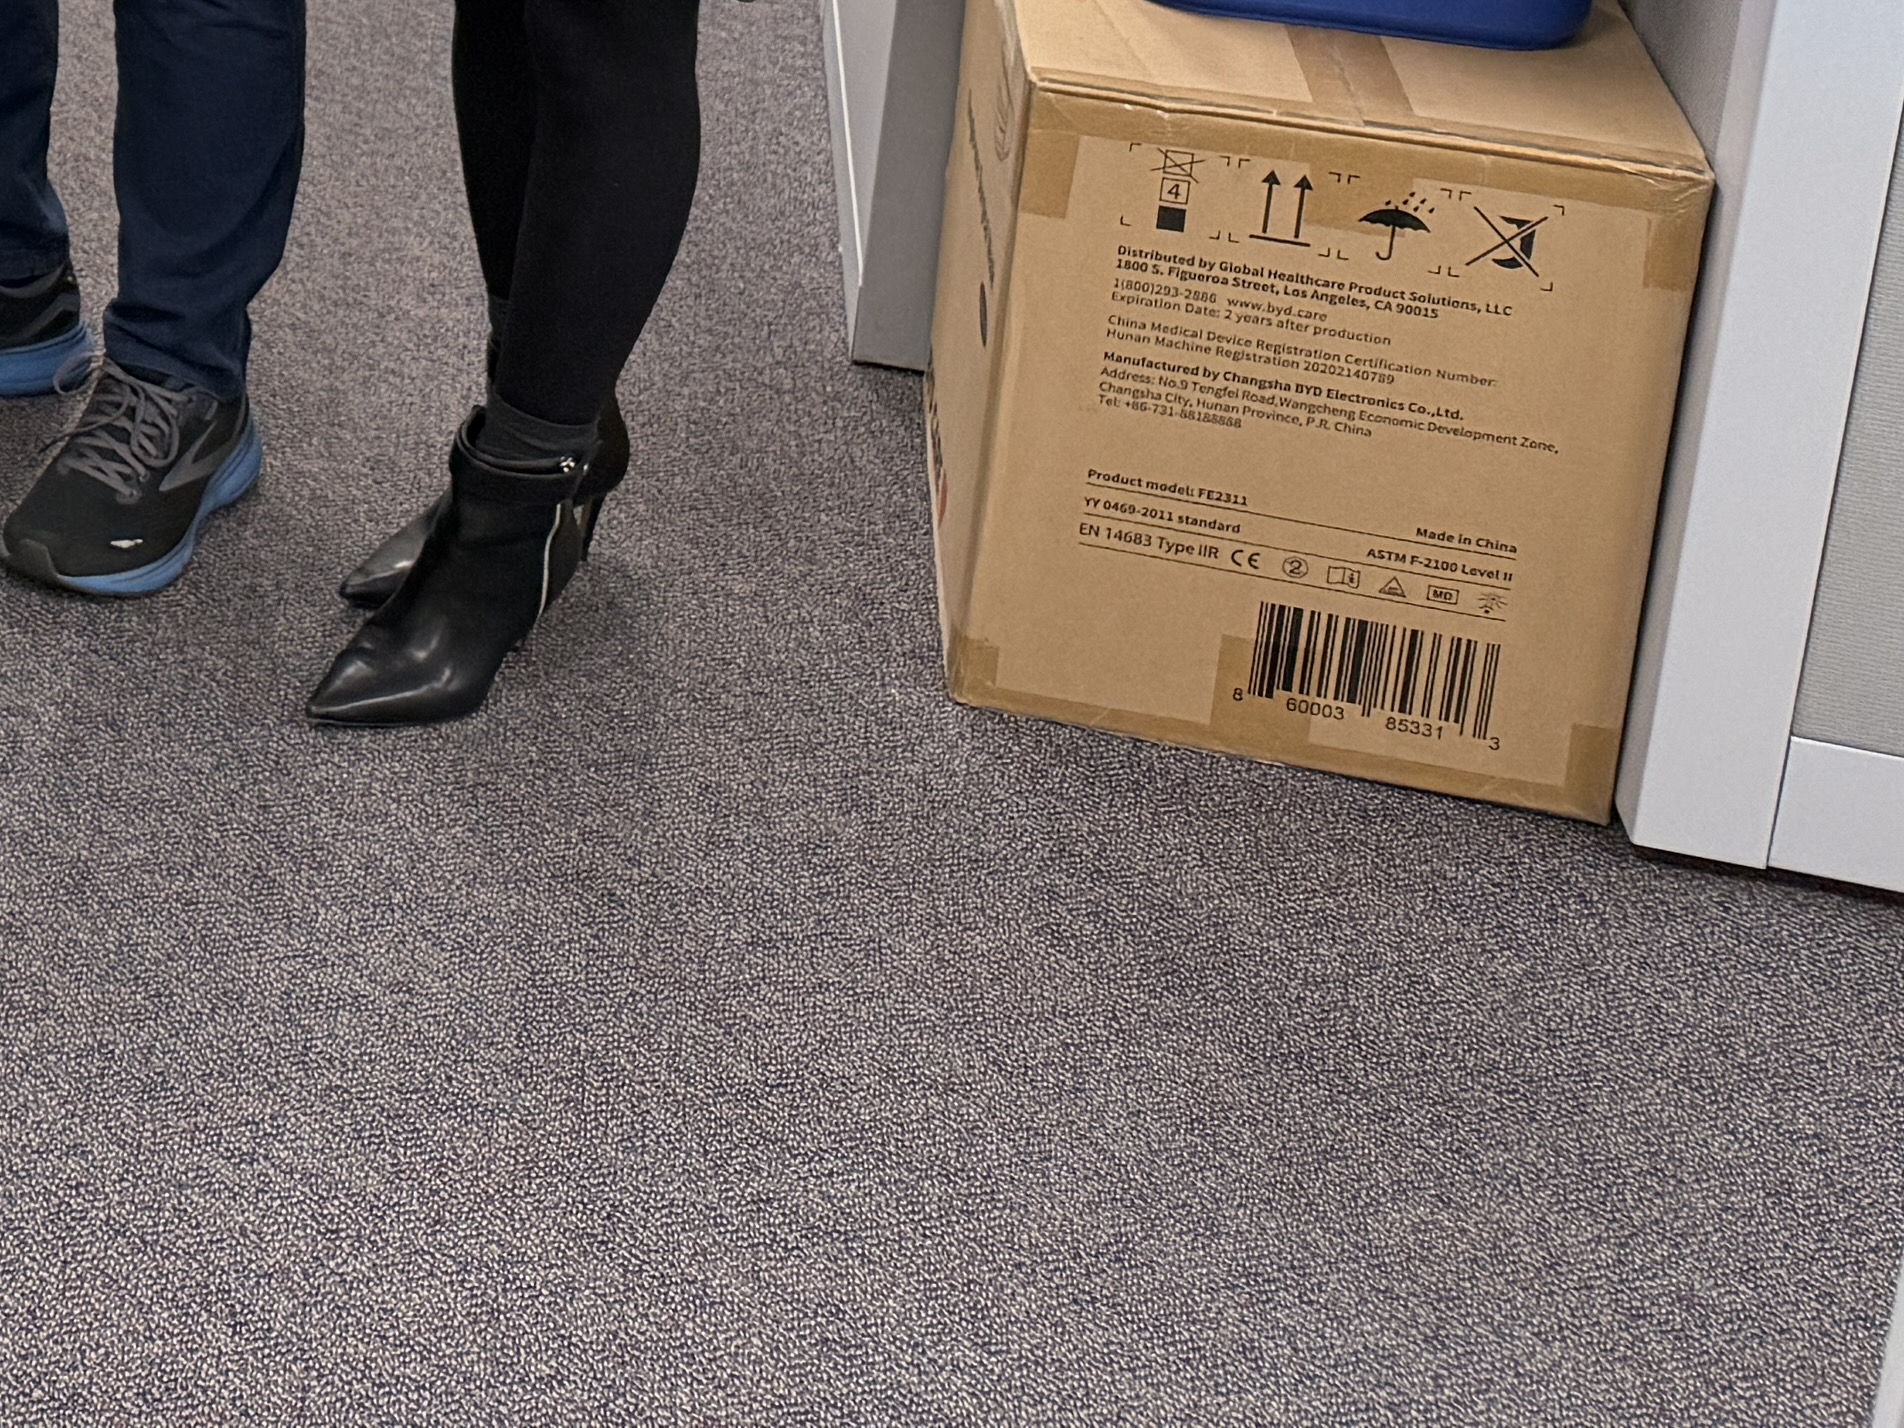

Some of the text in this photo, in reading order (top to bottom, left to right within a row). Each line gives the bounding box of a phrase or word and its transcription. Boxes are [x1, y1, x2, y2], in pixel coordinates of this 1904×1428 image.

[1167, 184, 1181, 200] 4
[1116, 258, 1439, 319] 1800 S. Figueroa Street, Los Angeles, CA 90015
[1117, 245, 1513, 317] Distributed by Global Healthcare Product Solutions, LLC
[1111, 291, 1181, 312] Expiration
[1185, 303, 1221, 319] Date:
[1235, 312, 1273, 327] years
[1276, 318, 1309, 333] after
[1313, 324, 1392, 346] production
[1227, 297, 1328, 322] www.byd.care
[1106, 329, 1151, 344] Hunan
[1154, 336, 1212, 355] Machine
[1215, 346, 1300, 371] Registration
[1108, 314, 1147, 330] China
[1150, 321, 1203, 340] Medical
[1206, 331, 1253, 348] Device
[1255, 339, 1341, 363] Registration
[1344, 353, 1432, 377] Certification
[1103, 351, 1200, 377] Manufactured
[1202, 367, 1220, 381] by
[1223, 371, 1291, 393] Changsha
[1295, 384, 1322, 397] BYD
[1326, 388, 1405, 411] Electronics
[1098, 382, 1162, 402] Changsha
[1164, 392, 1193, 409] City,
[1196, 398, 1240, 415] Hunan
[1242, 406, 1303, 428] Province,
[1334, 421, 1372, 438] China
[1100, 366, 1156, 386] Address:
[1158, 376, 1189, 391] No.9
[1191, 383, 1240, 401] Tengfei
[1358, 410, 1426, 432] Economic
[1427, 422, 1517, 447] Development
[1519, 437, 1559, 455] Zone,
[1087, 468, 1248, 507] Product model: FE2311
[1079, 522, 1100, 538] EN
[1105, 527, 1152, 547] 14683
[1157, 536, 1196, 557] Type
[1085, 496, 1242, 535] YY 0469-2011 standard
[1416, 527, 1518, 555] Made in China
[1366, 548, 1513, 583] ASTM F-2100 Level II
[1232, 687, 1501, 751] 8 60003 85331 3
